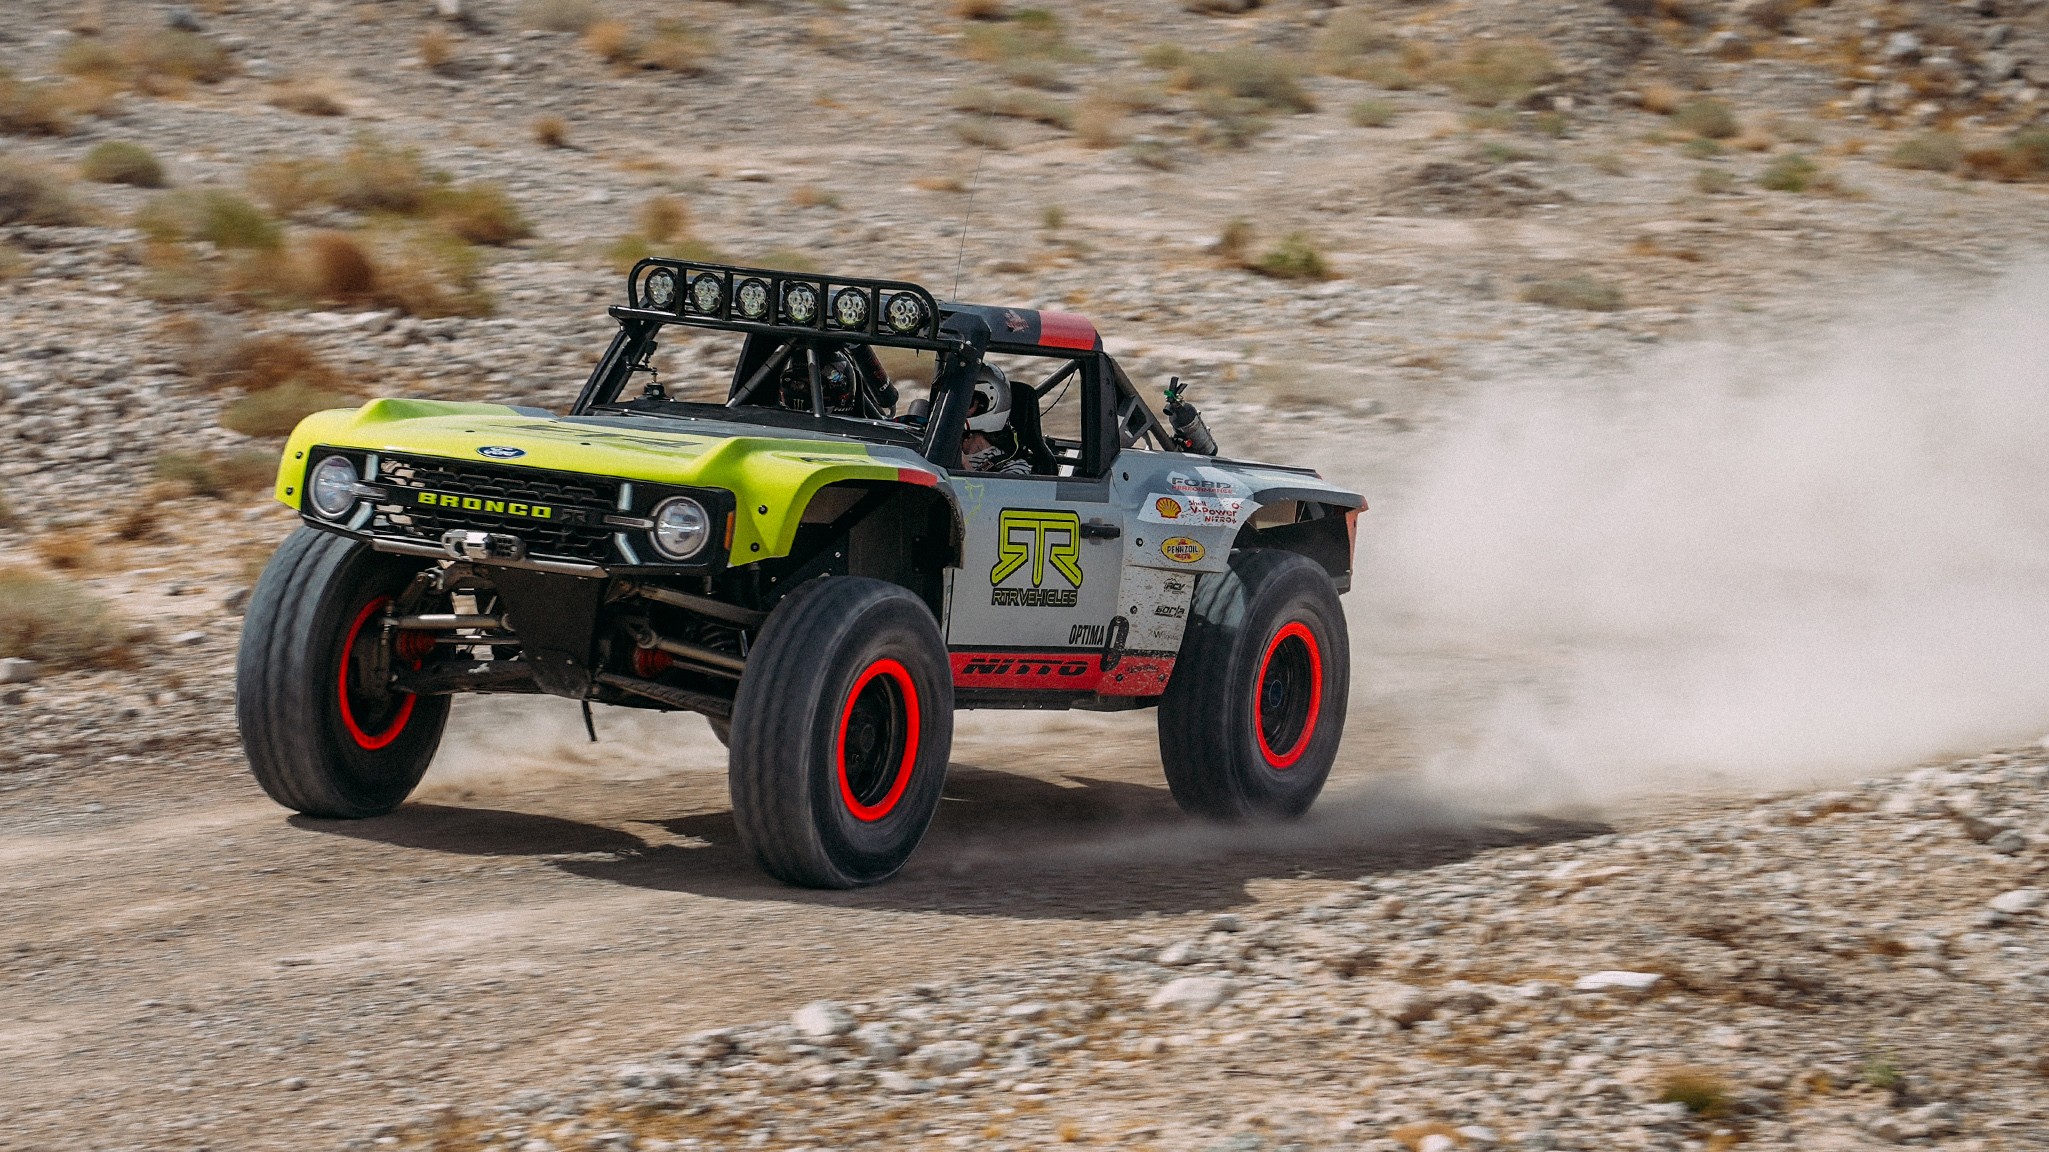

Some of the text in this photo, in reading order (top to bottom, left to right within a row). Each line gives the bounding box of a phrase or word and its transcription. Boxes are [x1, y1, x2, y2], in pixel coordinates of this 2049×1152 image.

[1171, 477, 1232, 489] FORD
[417, 491, 552, 519] BRONCO
[1190, 506, 1237, 517] V-Power
[1069, 624, 1105, 646] OPTIMA
[962, 658, 1090, 676] NITTO
